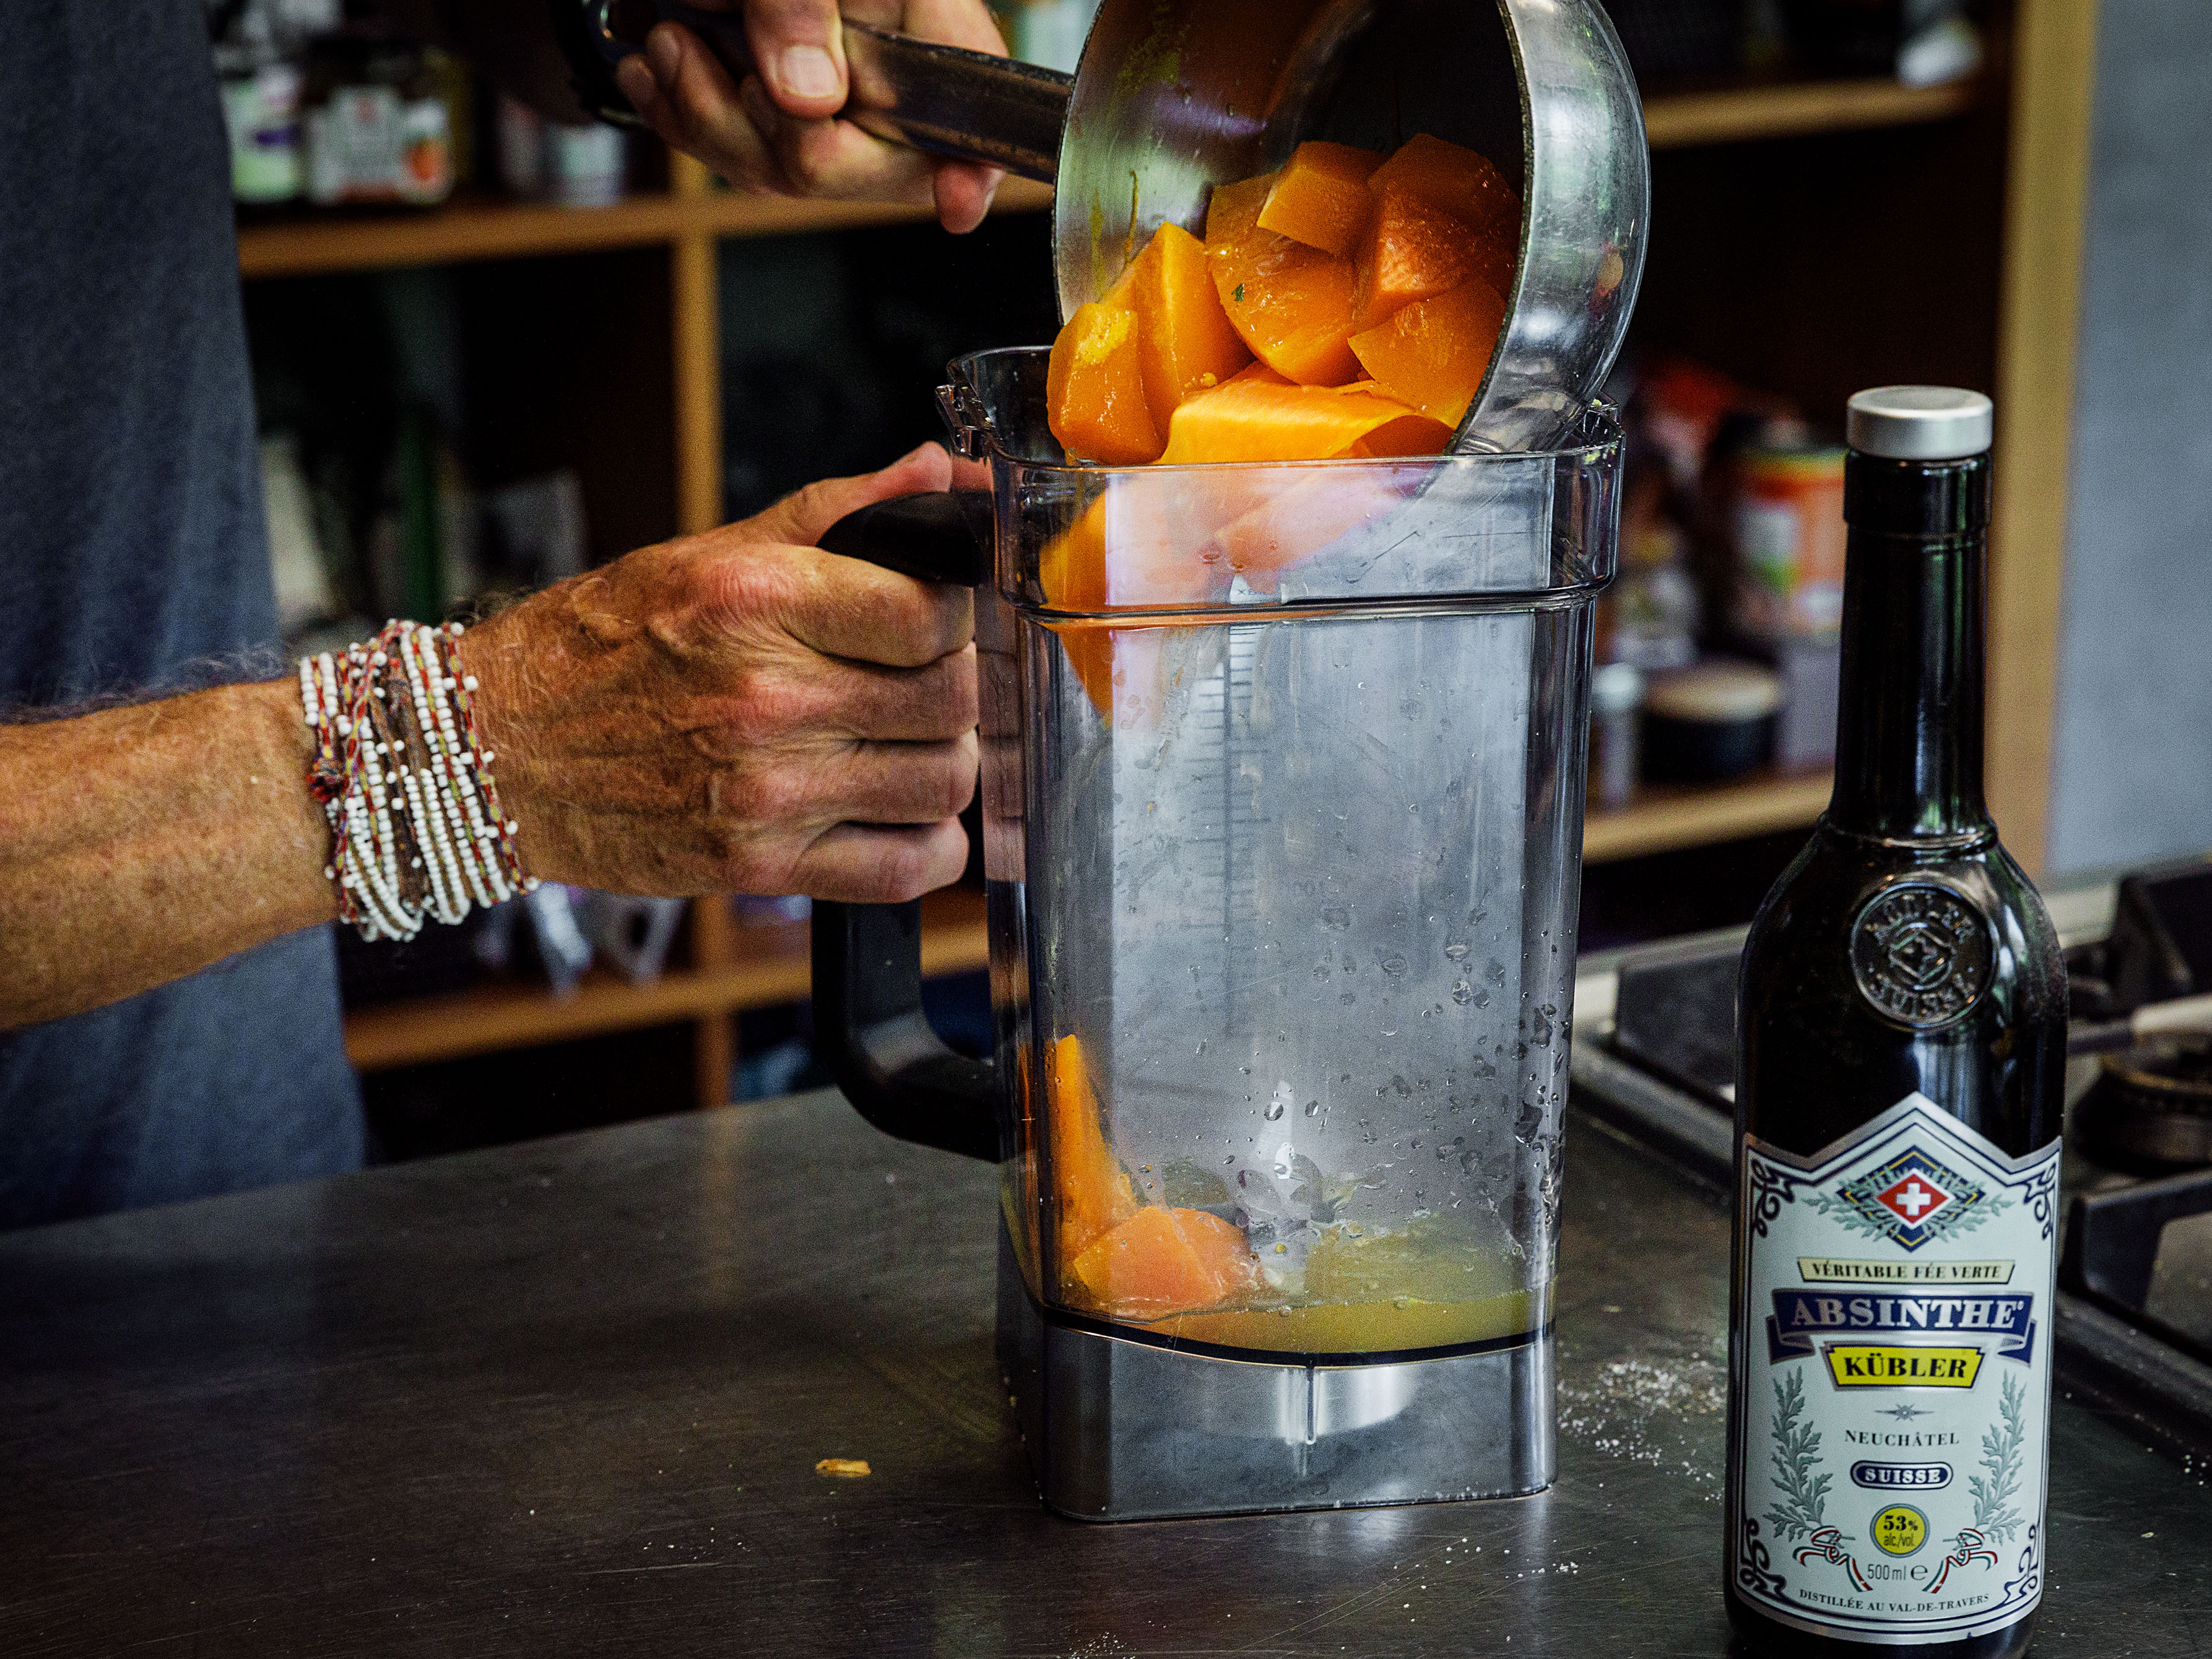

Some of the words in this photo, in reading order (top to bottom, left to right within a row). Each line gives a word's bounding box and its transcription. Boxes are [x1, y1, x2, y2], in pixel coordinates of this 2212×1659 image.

[1812, 1260, 1907, 1278] VÉRITABLE
[1914, 1262, 1946, 1278] FÉE
[1951, 1265, 2001, 1278] VERTE
[1844, 1353, 1967, 1378] KÜBLER
[1845, 1429, 1959, 1447] NEUCHÂTEL
[1865, 1468, 1941, 1484] SUISSE
[1883, 1515, 1918, 1531] 53%
[1799, 1588, 1863, 1609] DISTILLÉE
[1867, 1599, 1885, 1611] AU
